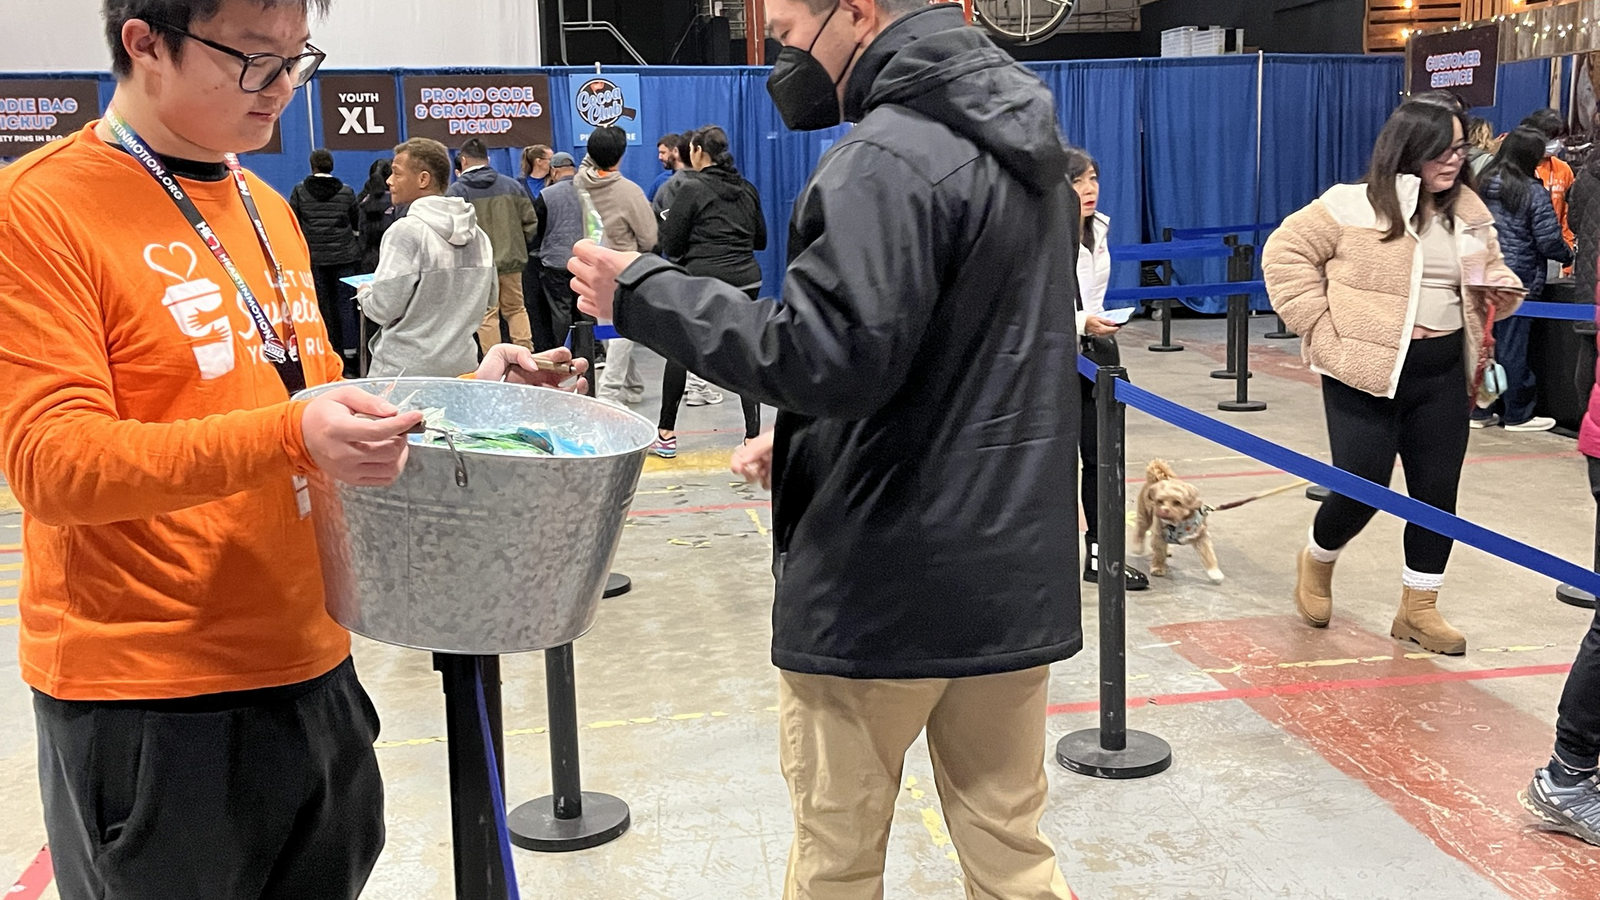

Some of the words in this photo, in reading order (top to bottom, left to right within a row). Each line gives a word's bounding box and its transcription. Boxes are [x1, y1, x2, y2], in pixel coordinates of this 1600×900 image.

[1426, 50, 1481, 72] CUSTOMER
[1430, 68, 1473, 88] SERVICE
[338, 92, 380, 103] YOUTH
[421, 87, 485, 103] PROMO
[486, 86, 534, 102] CODE
[577, 87, 621, 112] Cocoa
[38, 97, 78, 114] BAG
[415, 105, 428, 119] &
[429, 103, 490, 118] GROUP
[491, 101, 542, 117] SWAG
[587, 101, 623, 125] Club
[0, 114, 57, 130] ICKUP
[337, 106, 385, 134] XL
[449, 118, 512, 134] PICKUP
[265, 343, 284, 358] VOTE
